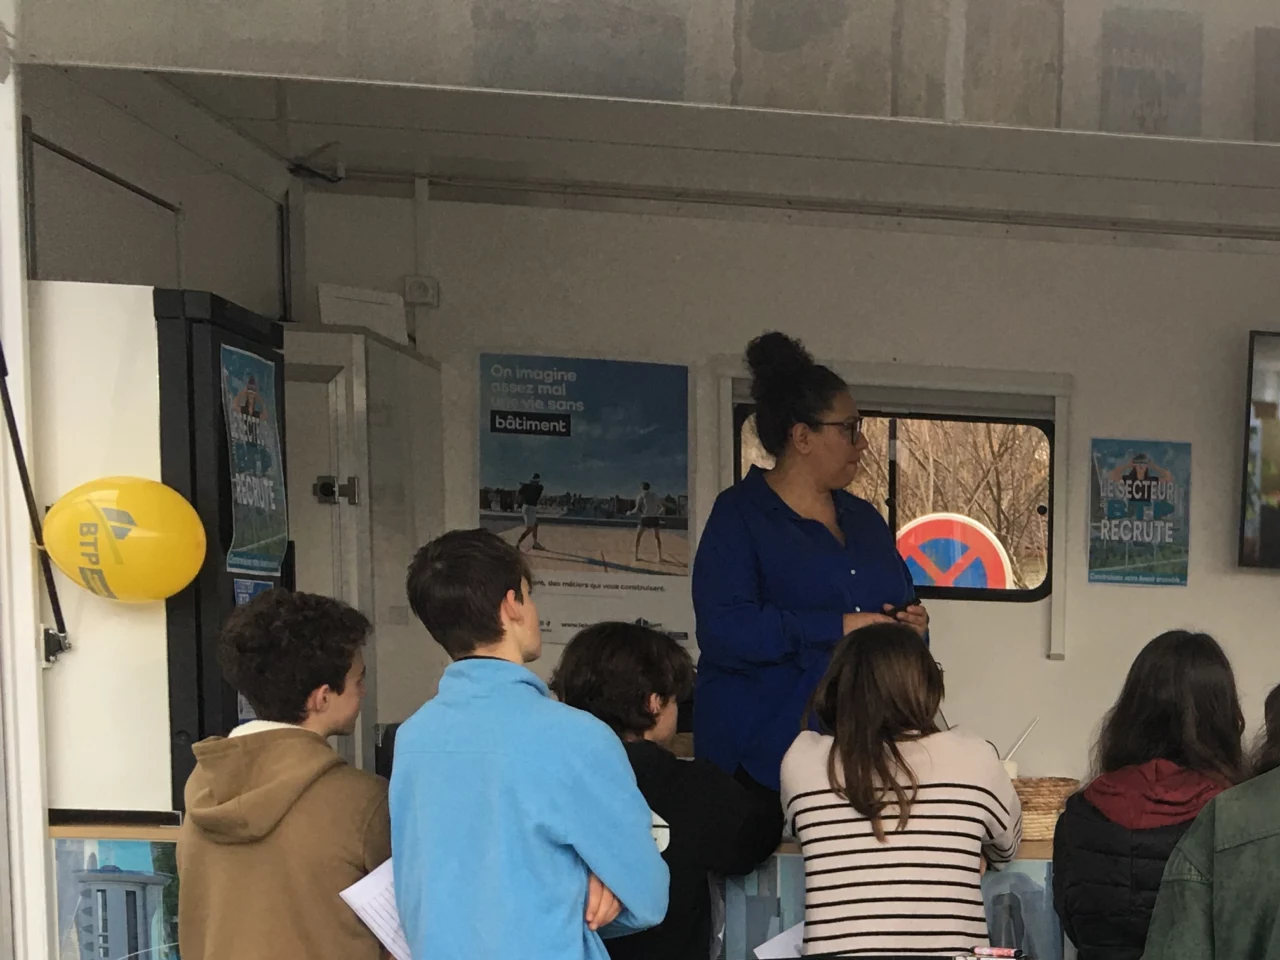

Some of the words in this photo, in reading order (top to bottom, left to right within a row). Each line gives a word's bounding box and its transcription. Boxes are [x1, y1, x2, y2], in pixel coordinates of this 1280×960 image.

[490, 363, 512, 378] On
[515, 365, 577, 383] imagine
[490, 382, 534, 394] assez
[537, 383, 567, 396] mal
[521, 395, 545, 411] vie
[547, 400, 585, 411] sans
[495, 415, 567, 432] bâtiment
[1100, 480, 1115, 498] LE
[1116, 480, 1175, 500] SECTEUR
[1100, 520, 1174, 543] RECRUTE
[79, 522, 101, 566] BTP
